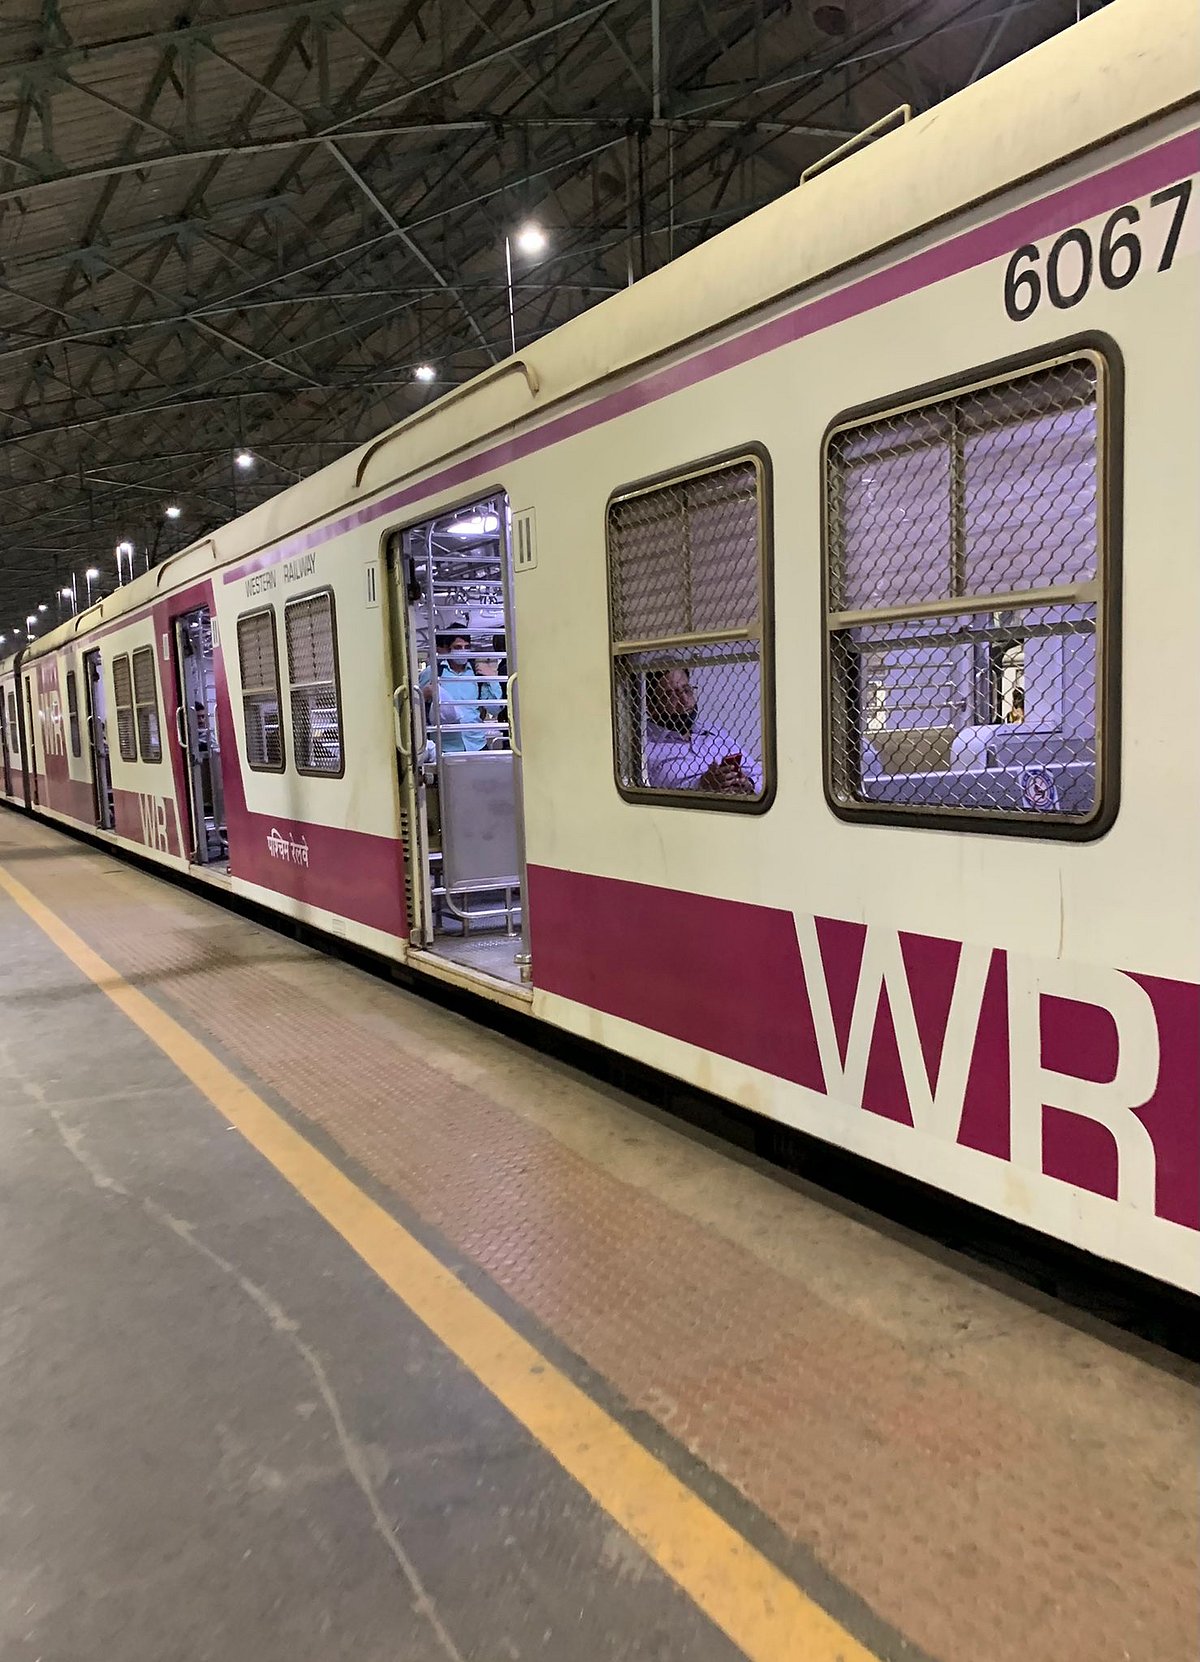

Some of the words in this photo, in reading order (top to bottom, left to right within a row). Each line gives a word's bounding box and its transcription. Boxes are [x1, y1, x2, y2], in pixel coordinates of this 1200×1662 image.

[1003, 179, 1193, 322] 6067
[245, 569, 276, 597] WESTERN
[283, 552, 316, 582] RAILWAY
[138, 786, 169, 853] WR
[289, 832, 309, 868] रेलवे
[792, 910, 1160, 1217] WR
